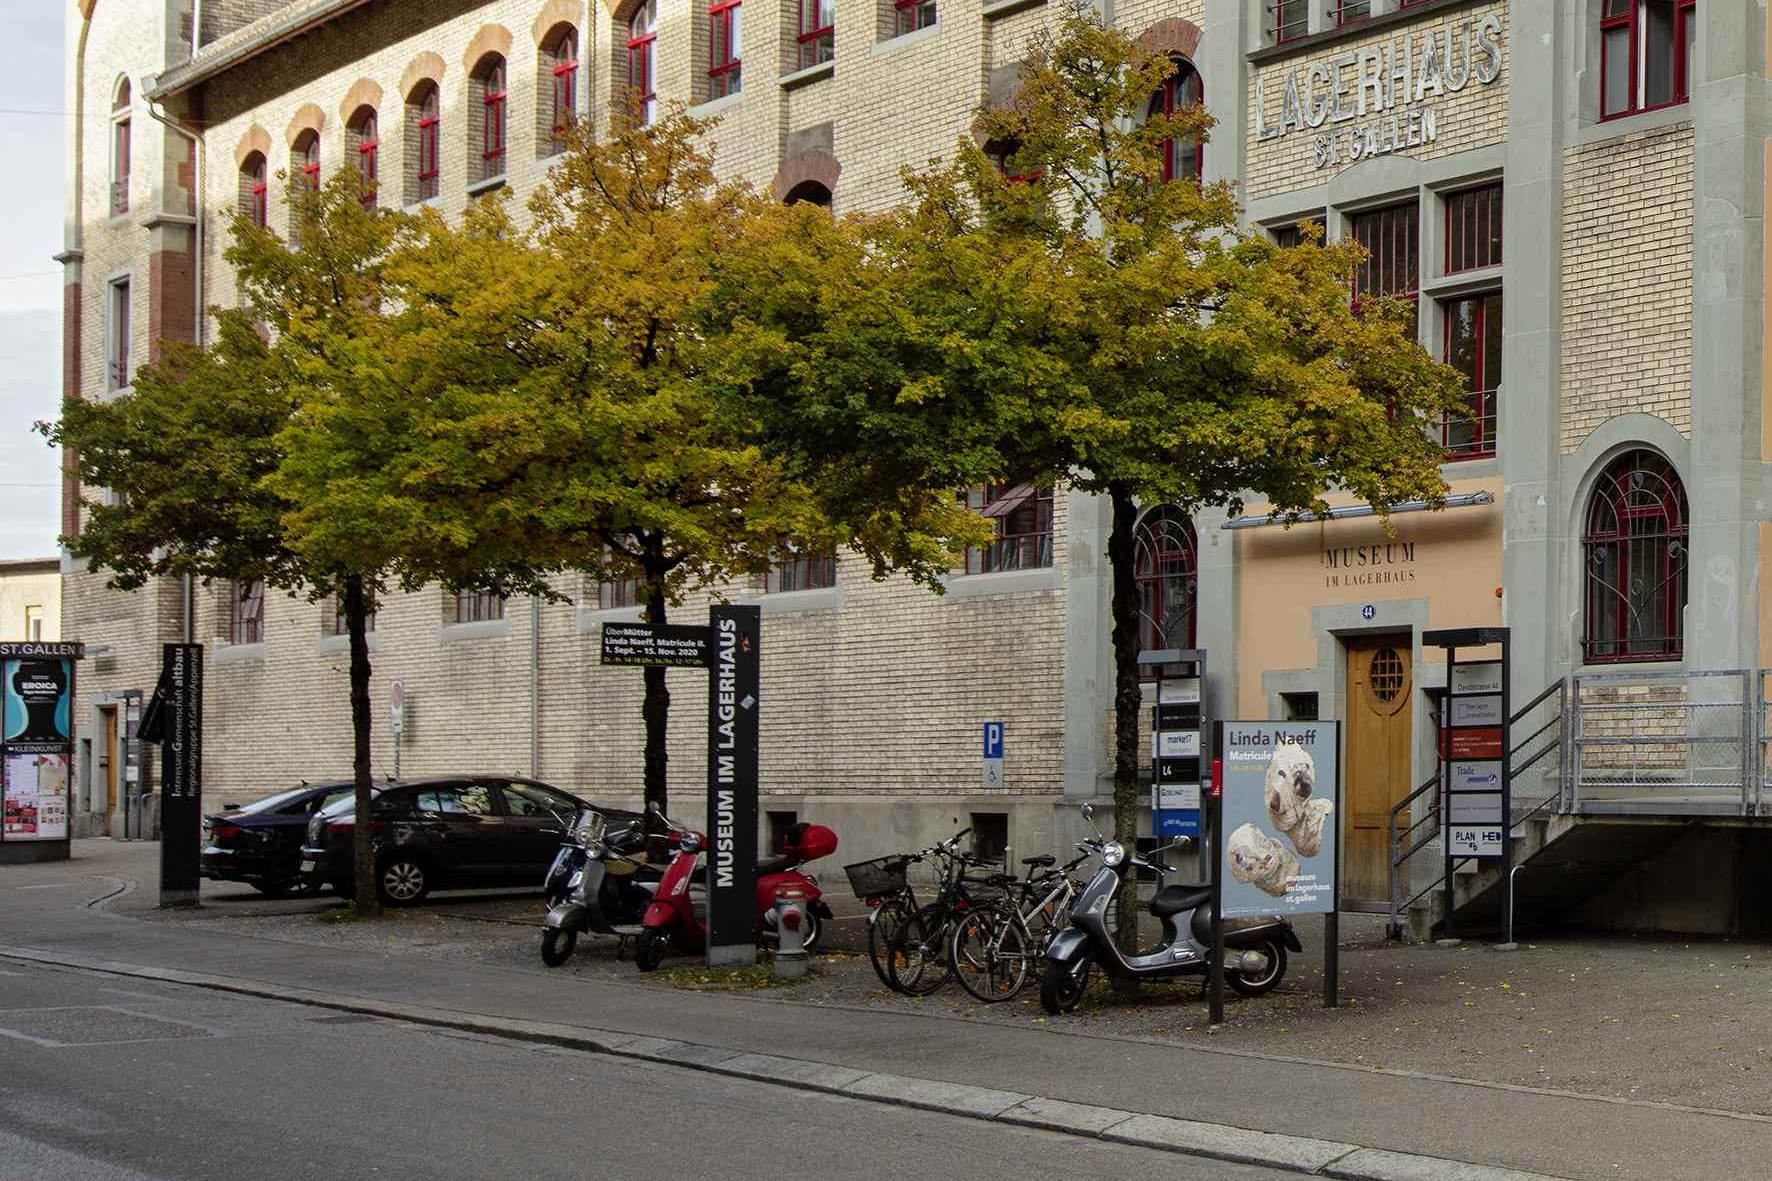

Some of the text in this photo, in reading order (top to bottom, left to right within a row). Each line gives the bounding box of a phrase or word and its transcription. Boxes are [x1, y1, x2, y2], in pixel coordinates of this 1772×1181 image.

[1255, 14, 1503, 142] LAGERHAUS
[1348, 106, 1437, 160] GALLEN
[1325, 541, 1415, 569] MUSEUM
[1326, 569, 1415, 588] IM LAGERHAUS
[1363, 606, 1373, 617] 44
[605, 626, 653, 637] ÜberMütter
[604, 637, 628, 645] Linda
[629, 638, 655, 647] Naeff,
[656, 639, 697, 648] Matricule
[0, 644, 76, 656] ST.GALLEN
[604, 646, 612, 654] 1.
[614, 646, 636, 656] Sept.
[644, 647, 656, 655] 15.
[657, 648, 677, 656] Nov.
[678, 648, 698, 656] 2020
[171, 647, 184, 687] altbau
[22, 682, 58, 690] EROICA
[1458, 682, 1490, 691] Davidstrasse
[988, 724, 1000, 755] P
[1229, 729, 1317, 746] Linda Naeff
[14, 745, 63, 753] KLEINKUNST
[716, 618, 737, 888] MUSEUM IM LAGERHAUS
[1229, 750, 1272, 761] Matricule
[187, 729, 199, 798] Regionalgruppe
[1455, 831, 1475, 841] PLAN
[1285, 874, 1316, 882] museum
[1285, 883, 1331, 893] im lagerhaus
